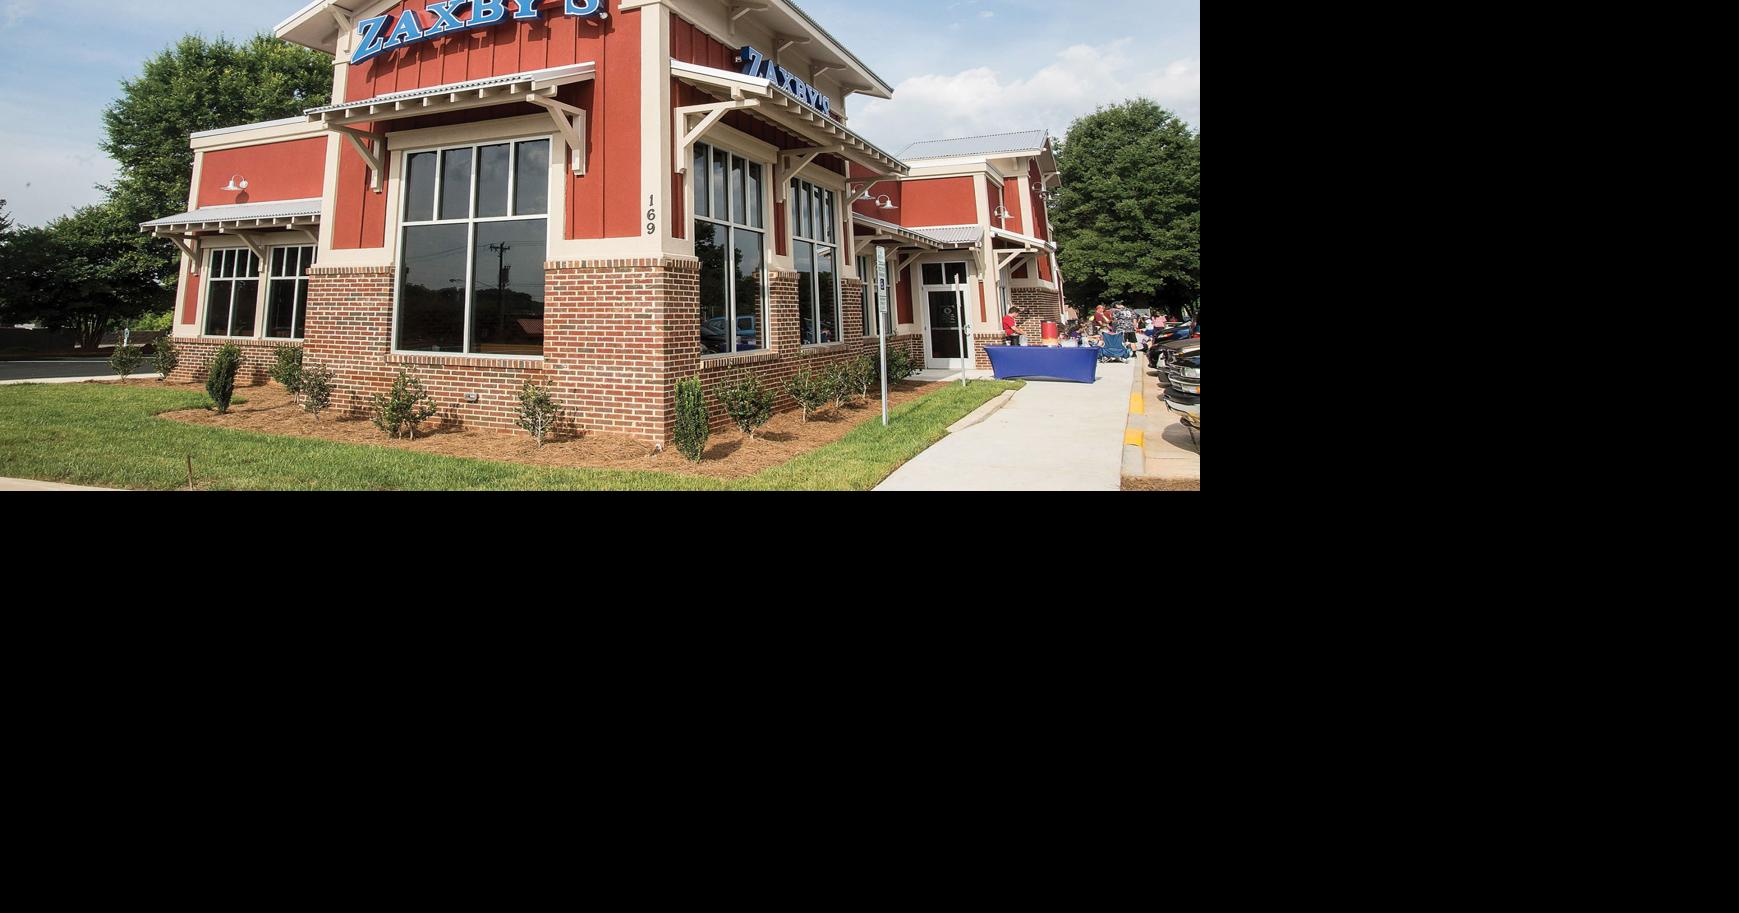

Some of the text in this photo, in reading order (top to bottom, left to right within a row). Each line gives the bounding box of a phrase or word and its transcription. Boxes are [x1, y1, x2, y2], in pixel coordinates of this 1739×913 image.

[350, 0, 600, 63] ZAXBYS
[744, 46, 830, 116] ZAXBY'S
[646, 194, 656, 235] 169
